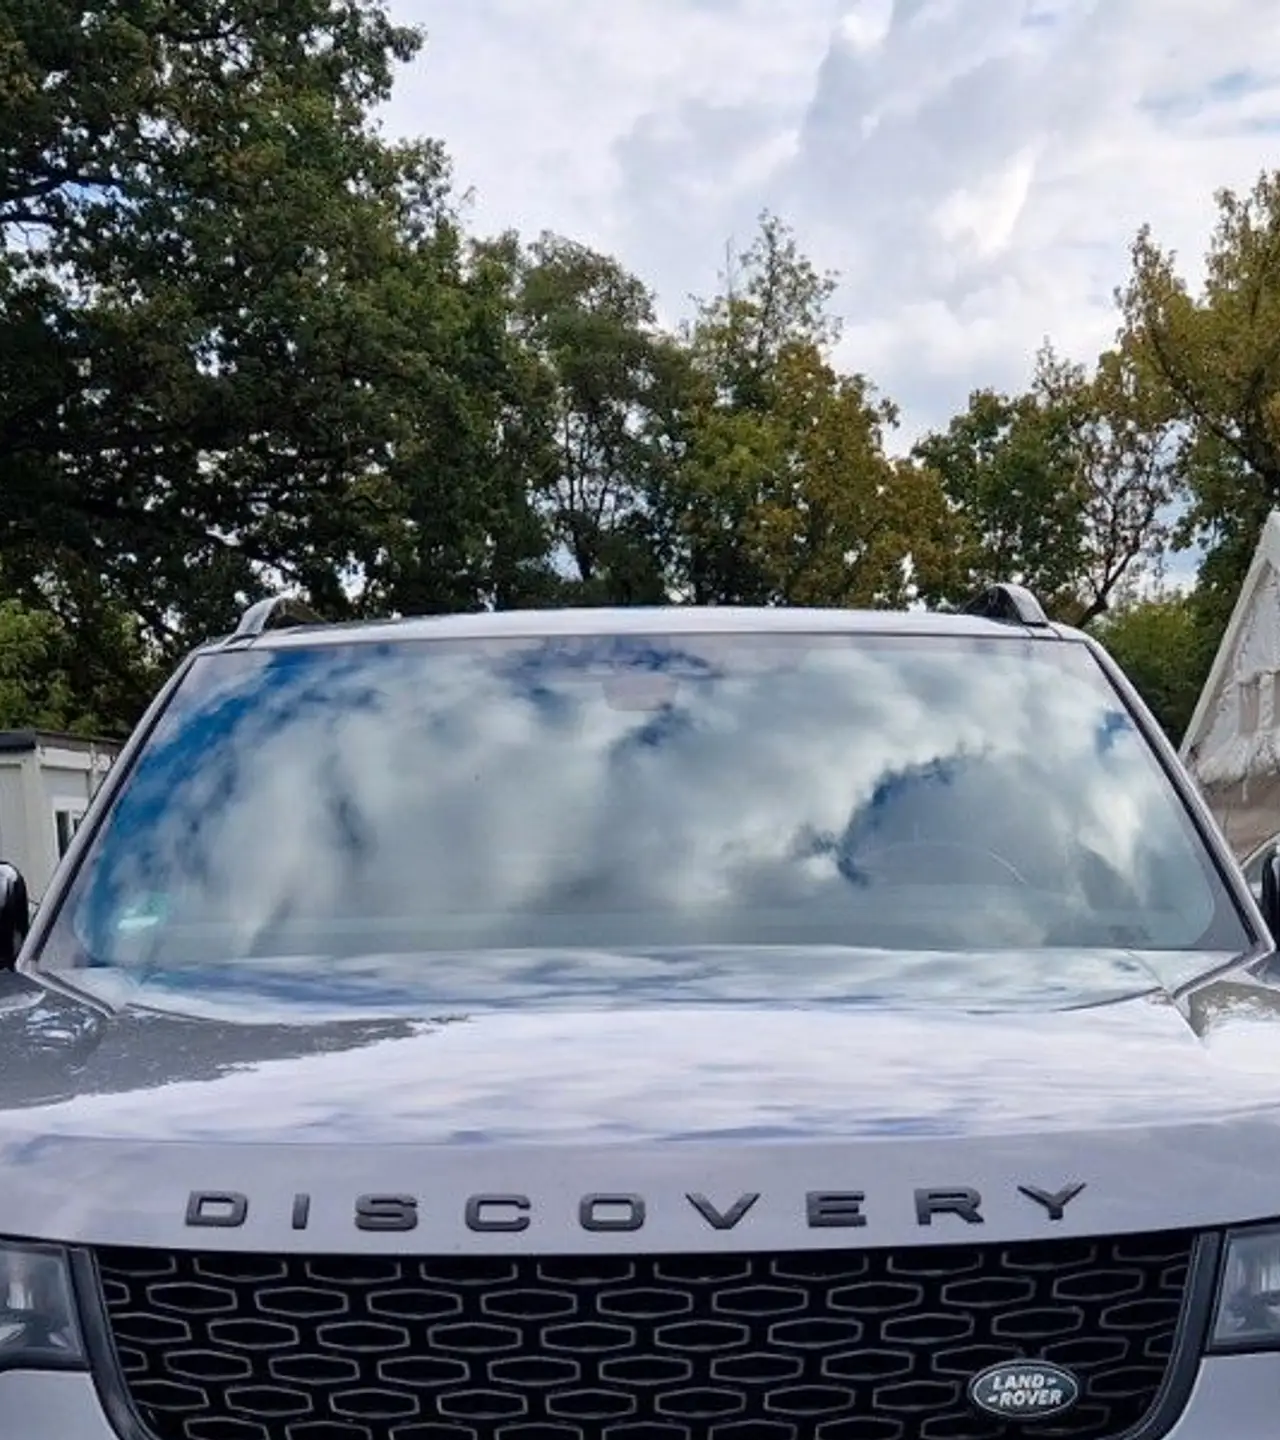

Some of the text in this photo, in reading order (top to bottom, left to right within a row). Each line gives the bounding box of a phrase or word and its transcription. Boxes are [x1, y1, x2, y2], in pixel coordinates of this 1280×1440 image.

[184, 1181, 1088, 1233] DISCOVERY
[992, 1373, 1046, 1391] LAND
[999, 1389, 1063, 1408] ROVER
